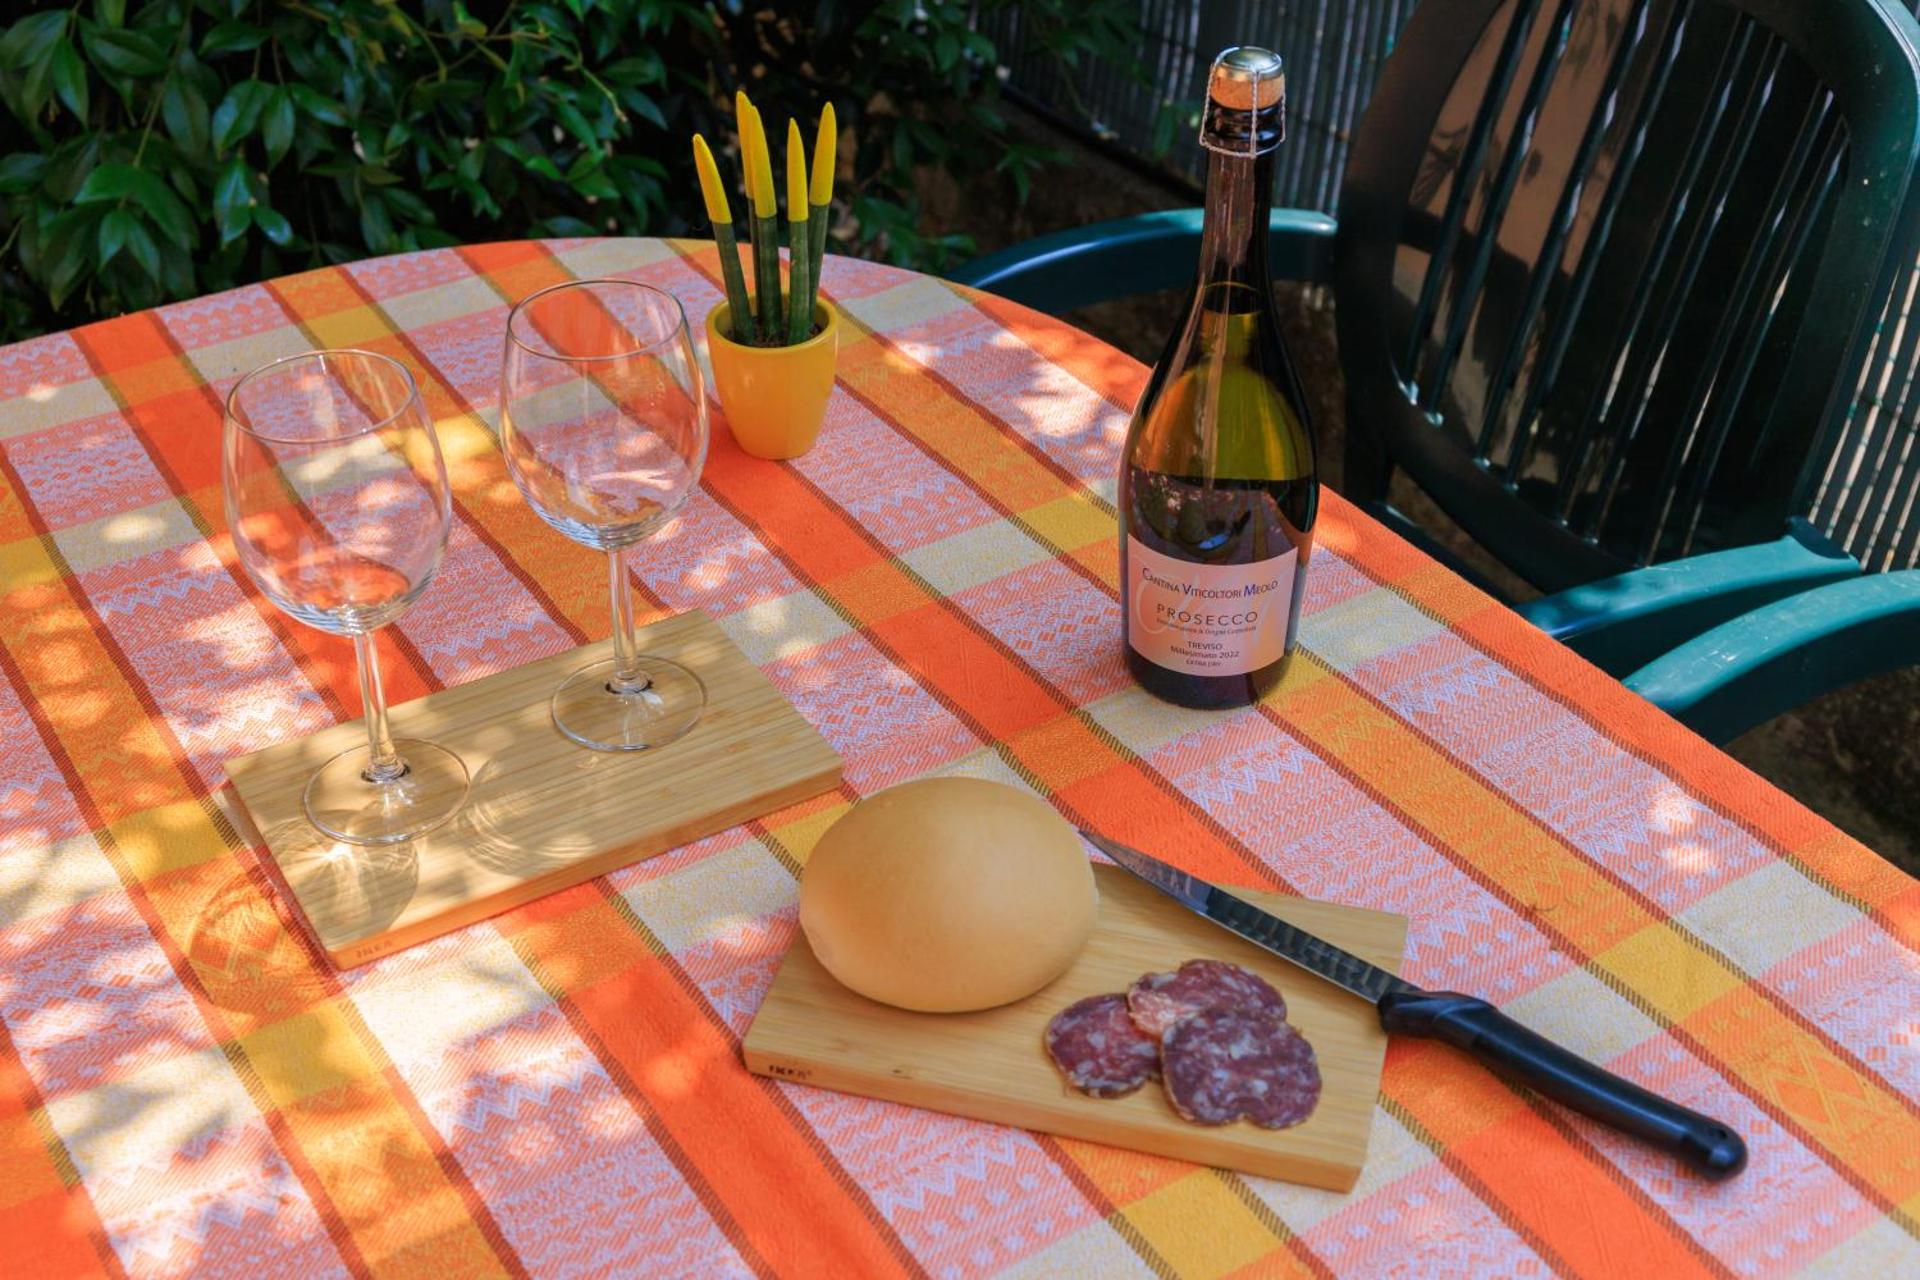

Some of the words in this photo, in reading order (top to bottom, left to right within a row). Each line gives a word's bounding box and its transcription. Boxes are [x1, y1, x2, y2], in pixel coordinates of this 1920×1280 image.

[1156, 603, 1258, 627] PROSECCO
[1187, 640, 1223, 651] TREVISO
[1219, 650, 1240, 659] 2022
